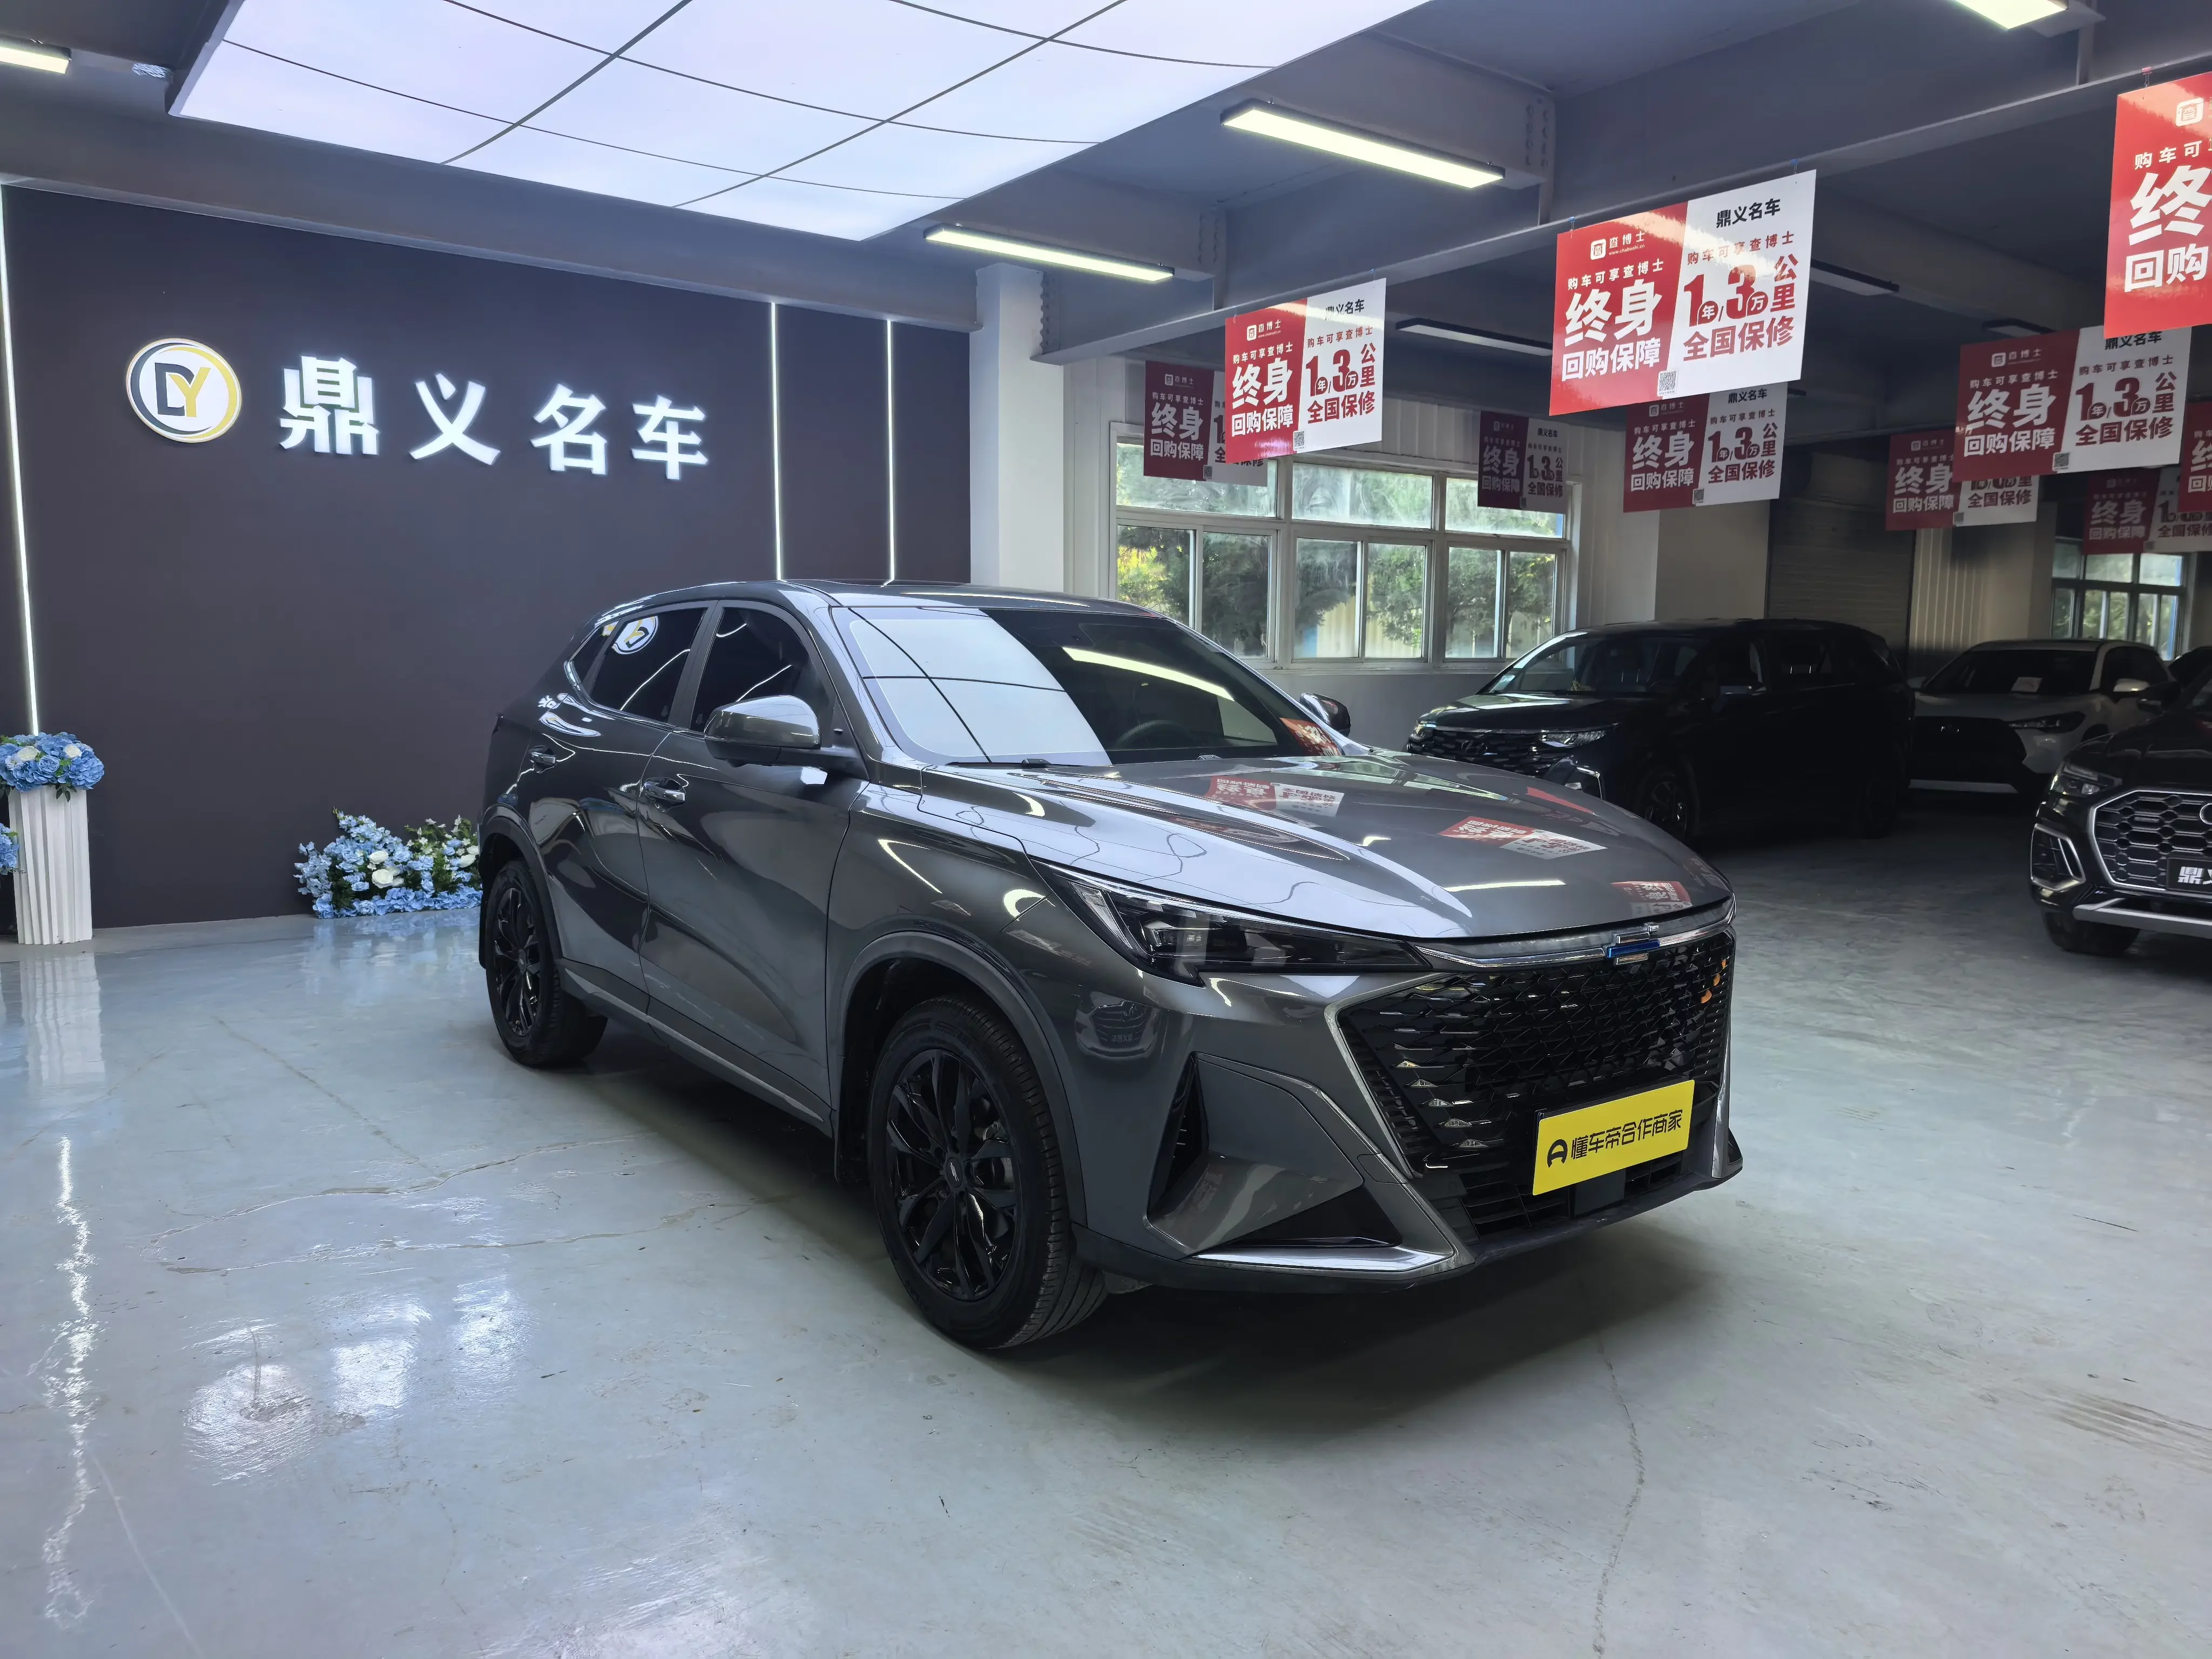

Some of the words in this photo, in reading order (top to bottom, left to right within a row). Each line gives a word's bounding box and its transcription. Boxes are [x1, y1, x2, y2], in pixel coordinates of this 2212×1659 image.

[1716, 199, 1780, 228] 鼎义名车
[1609, 231, 1645, 249] 查博士
[1688, 231, 1794, 265] 购车可享查博士
[1568, 258, 1664, 291] 购车可享查博士
[2125, 243, 2209, 293] 回购
[1565, 279, 1662, 347] 终身
[1233, 341, 1293, 364] 购车可享查博士
[1307, 325, 1373, 348] 购车可享查博士
[1683, 315, 1793, 362] 全国保修
[1562, 337, 1660, 381] 回购保障
[2079, 354, 2173, 375] 购车可享查博士
[154, 362, 211, 418] DY
[1232, 357, 1292, 409] 终身
[1970, 369, 2058, 389] 购车可享查博士
[1307, 390, 1375, 424] 全国保修
[1728, 388, 1767, 404] 鼎义名车
[1967, 383, 2056, 430] 终身
[280, 355, 709, 480] 鼎义名车
[1151, 402, 1203, 441] 终身
[1232, 403, 1293, 437] 回购保障
[2075, 416, 2173, 446] 全国保修
[1150, 439, 1204, 461] 回购保障
[1633, 430, 1694, 470] 终身
[1964, 427, 2055, 457] 回购保障
[1483, 444, 1520, 476] 终身
[1708, 460, 1775, 484] 全国保修
[1631, 468, 1694, 491] 回购保障
[1894, 463, 1953, 495] 终身
[2188, 475, 2212, 493] 回
[1893, 494, 1954, 514] 回购保障
[1968, 489, 2032, 508] 全国保修
[2090, 500, 2147, 524] 终身
[1571, 1110, 1683, 1159] 懂车帝合作商家
